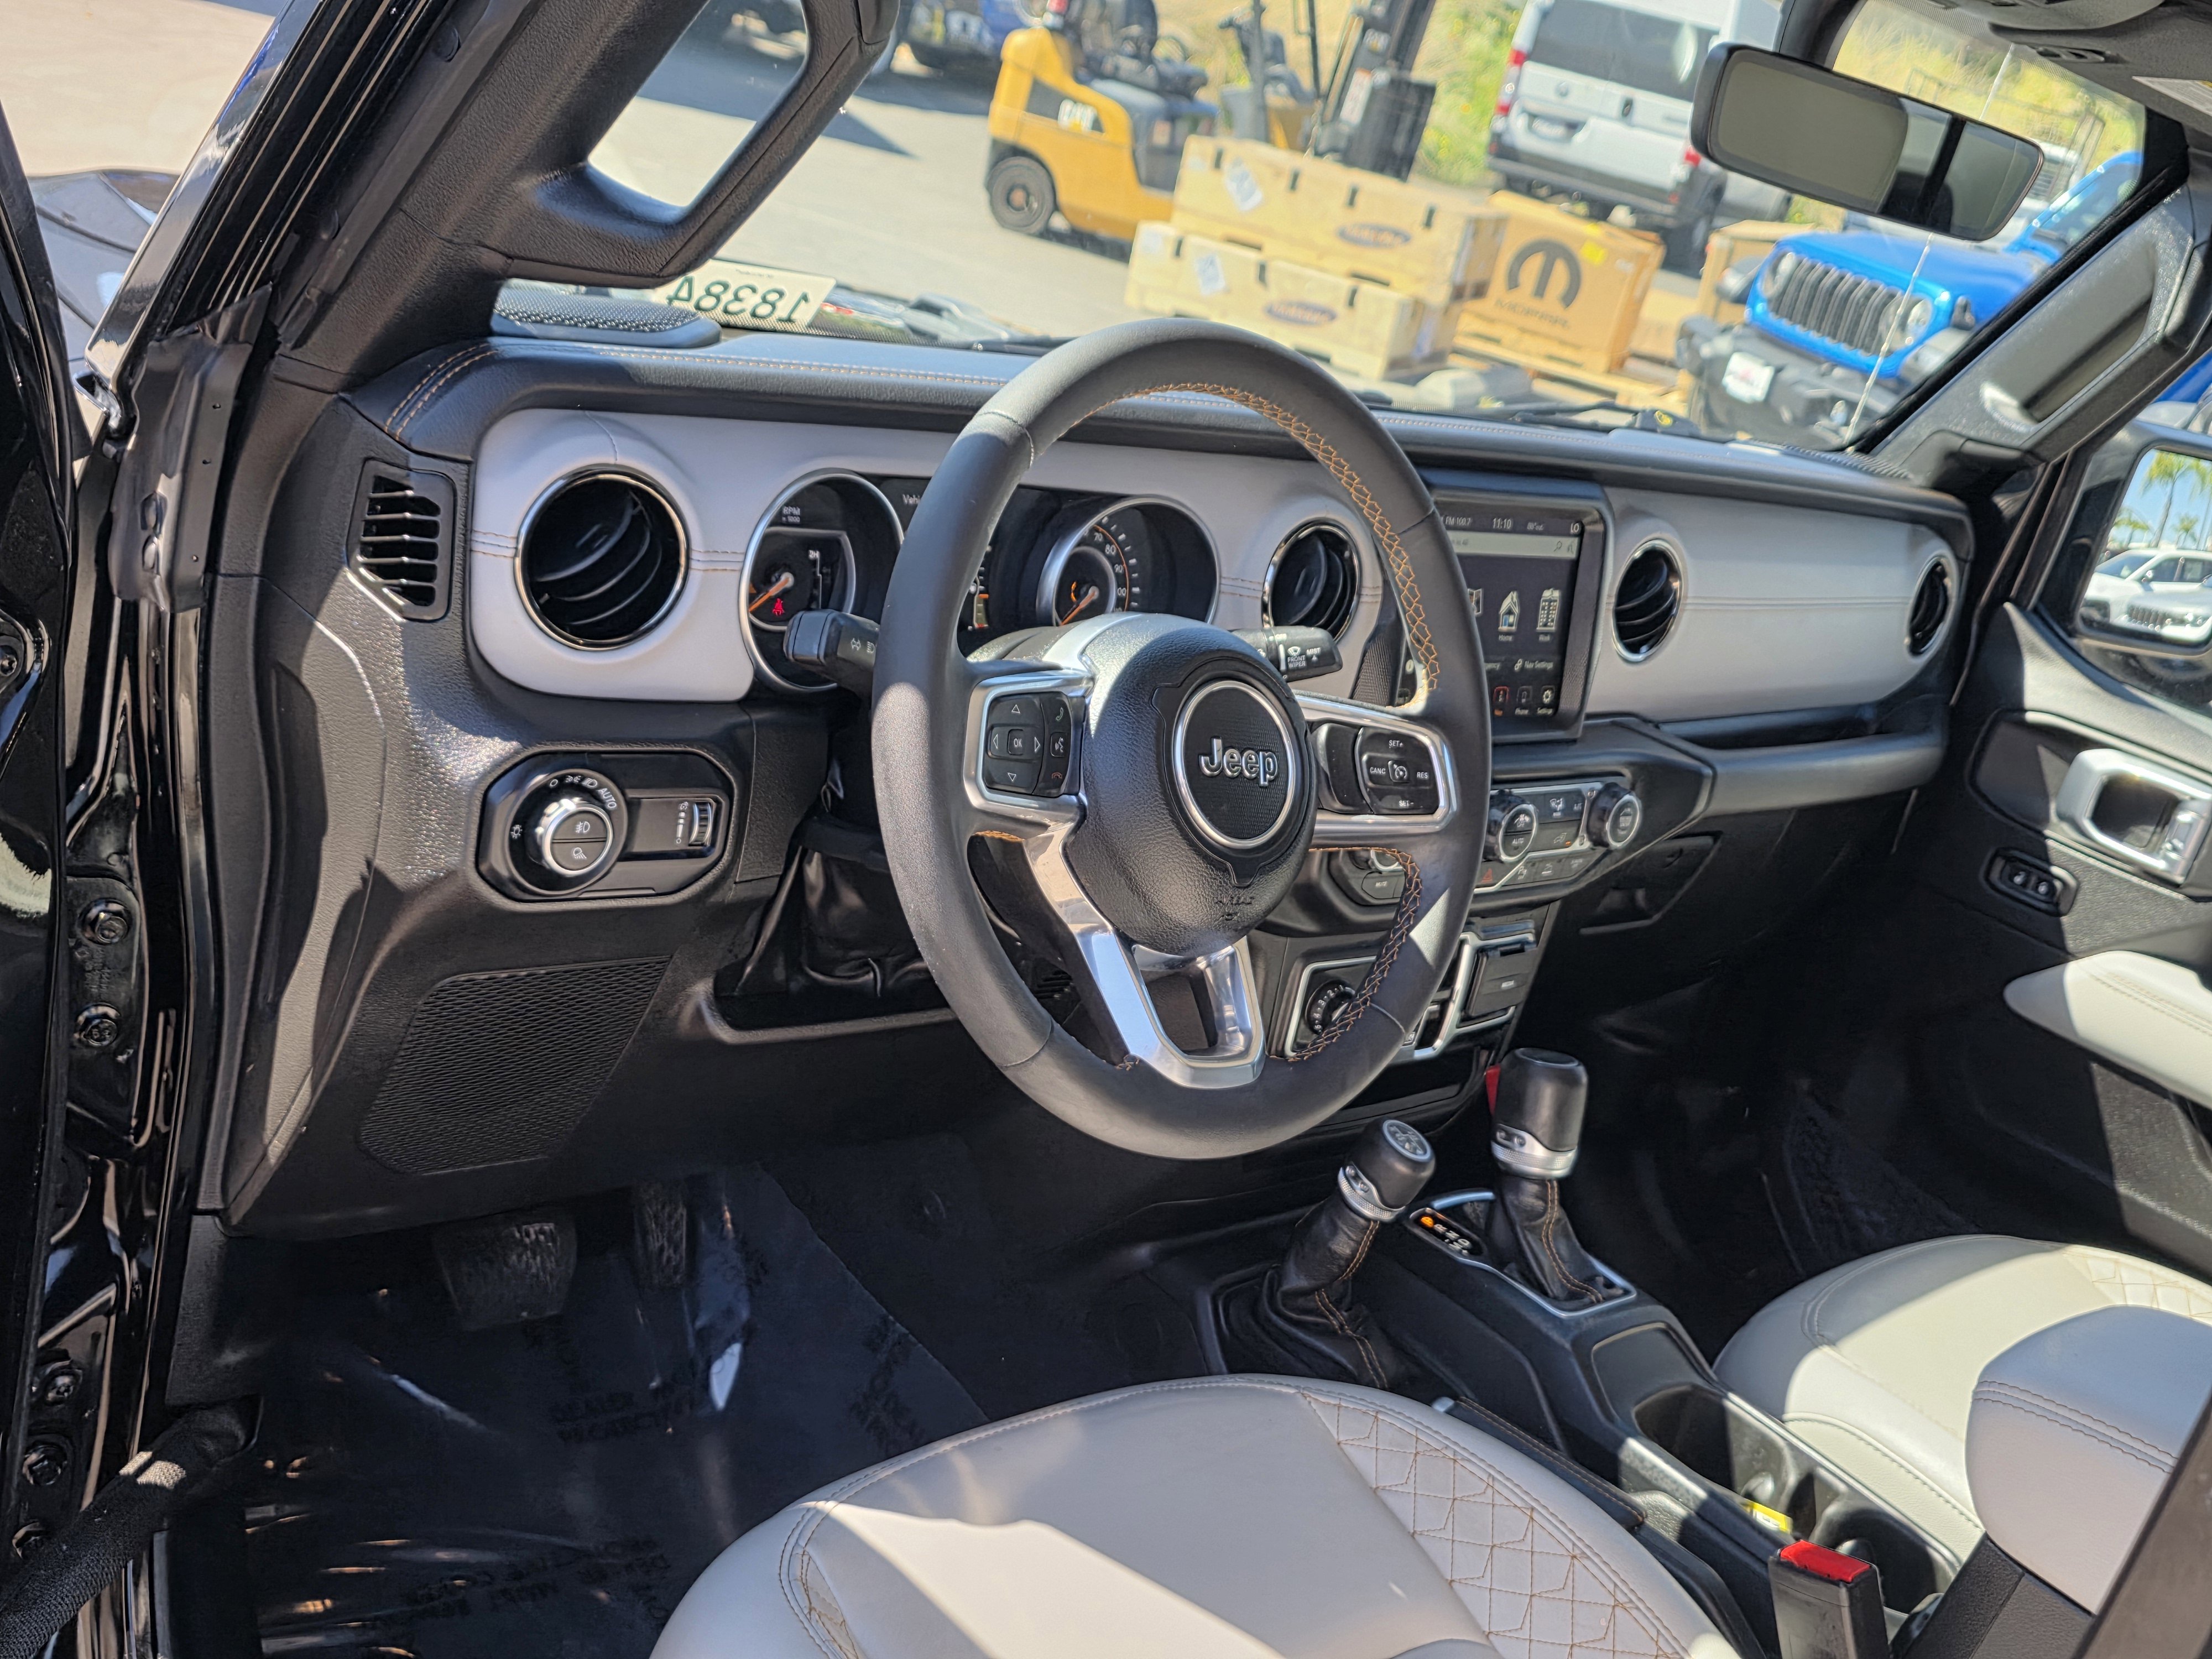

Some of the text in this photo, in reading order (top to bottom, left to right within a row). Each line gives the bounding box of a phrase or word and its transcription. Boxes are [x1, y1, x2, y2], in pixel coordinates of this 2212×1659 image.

[782, 506, 801, 515] RPM
[1493, 518, 1512, 529] 11:10
[1093, 533, 1103, 542] 70
[1105, 545, 1117, 555] 80
[1114, 564, 1123, 573] 90
[1117, 587, 1127, 596] 00
[1288, 660, 1306, 669] WIPER
[1013, 738, 1022, 748] OK
[1198, 737, 1278, 787] Jeep
[596, 787, 617, 808] AUTO
[1434, 1224, 1448, 1234] R
[1445, 1230, 1460, 1240] N
[1457, 1238, 1472, 1250] D
